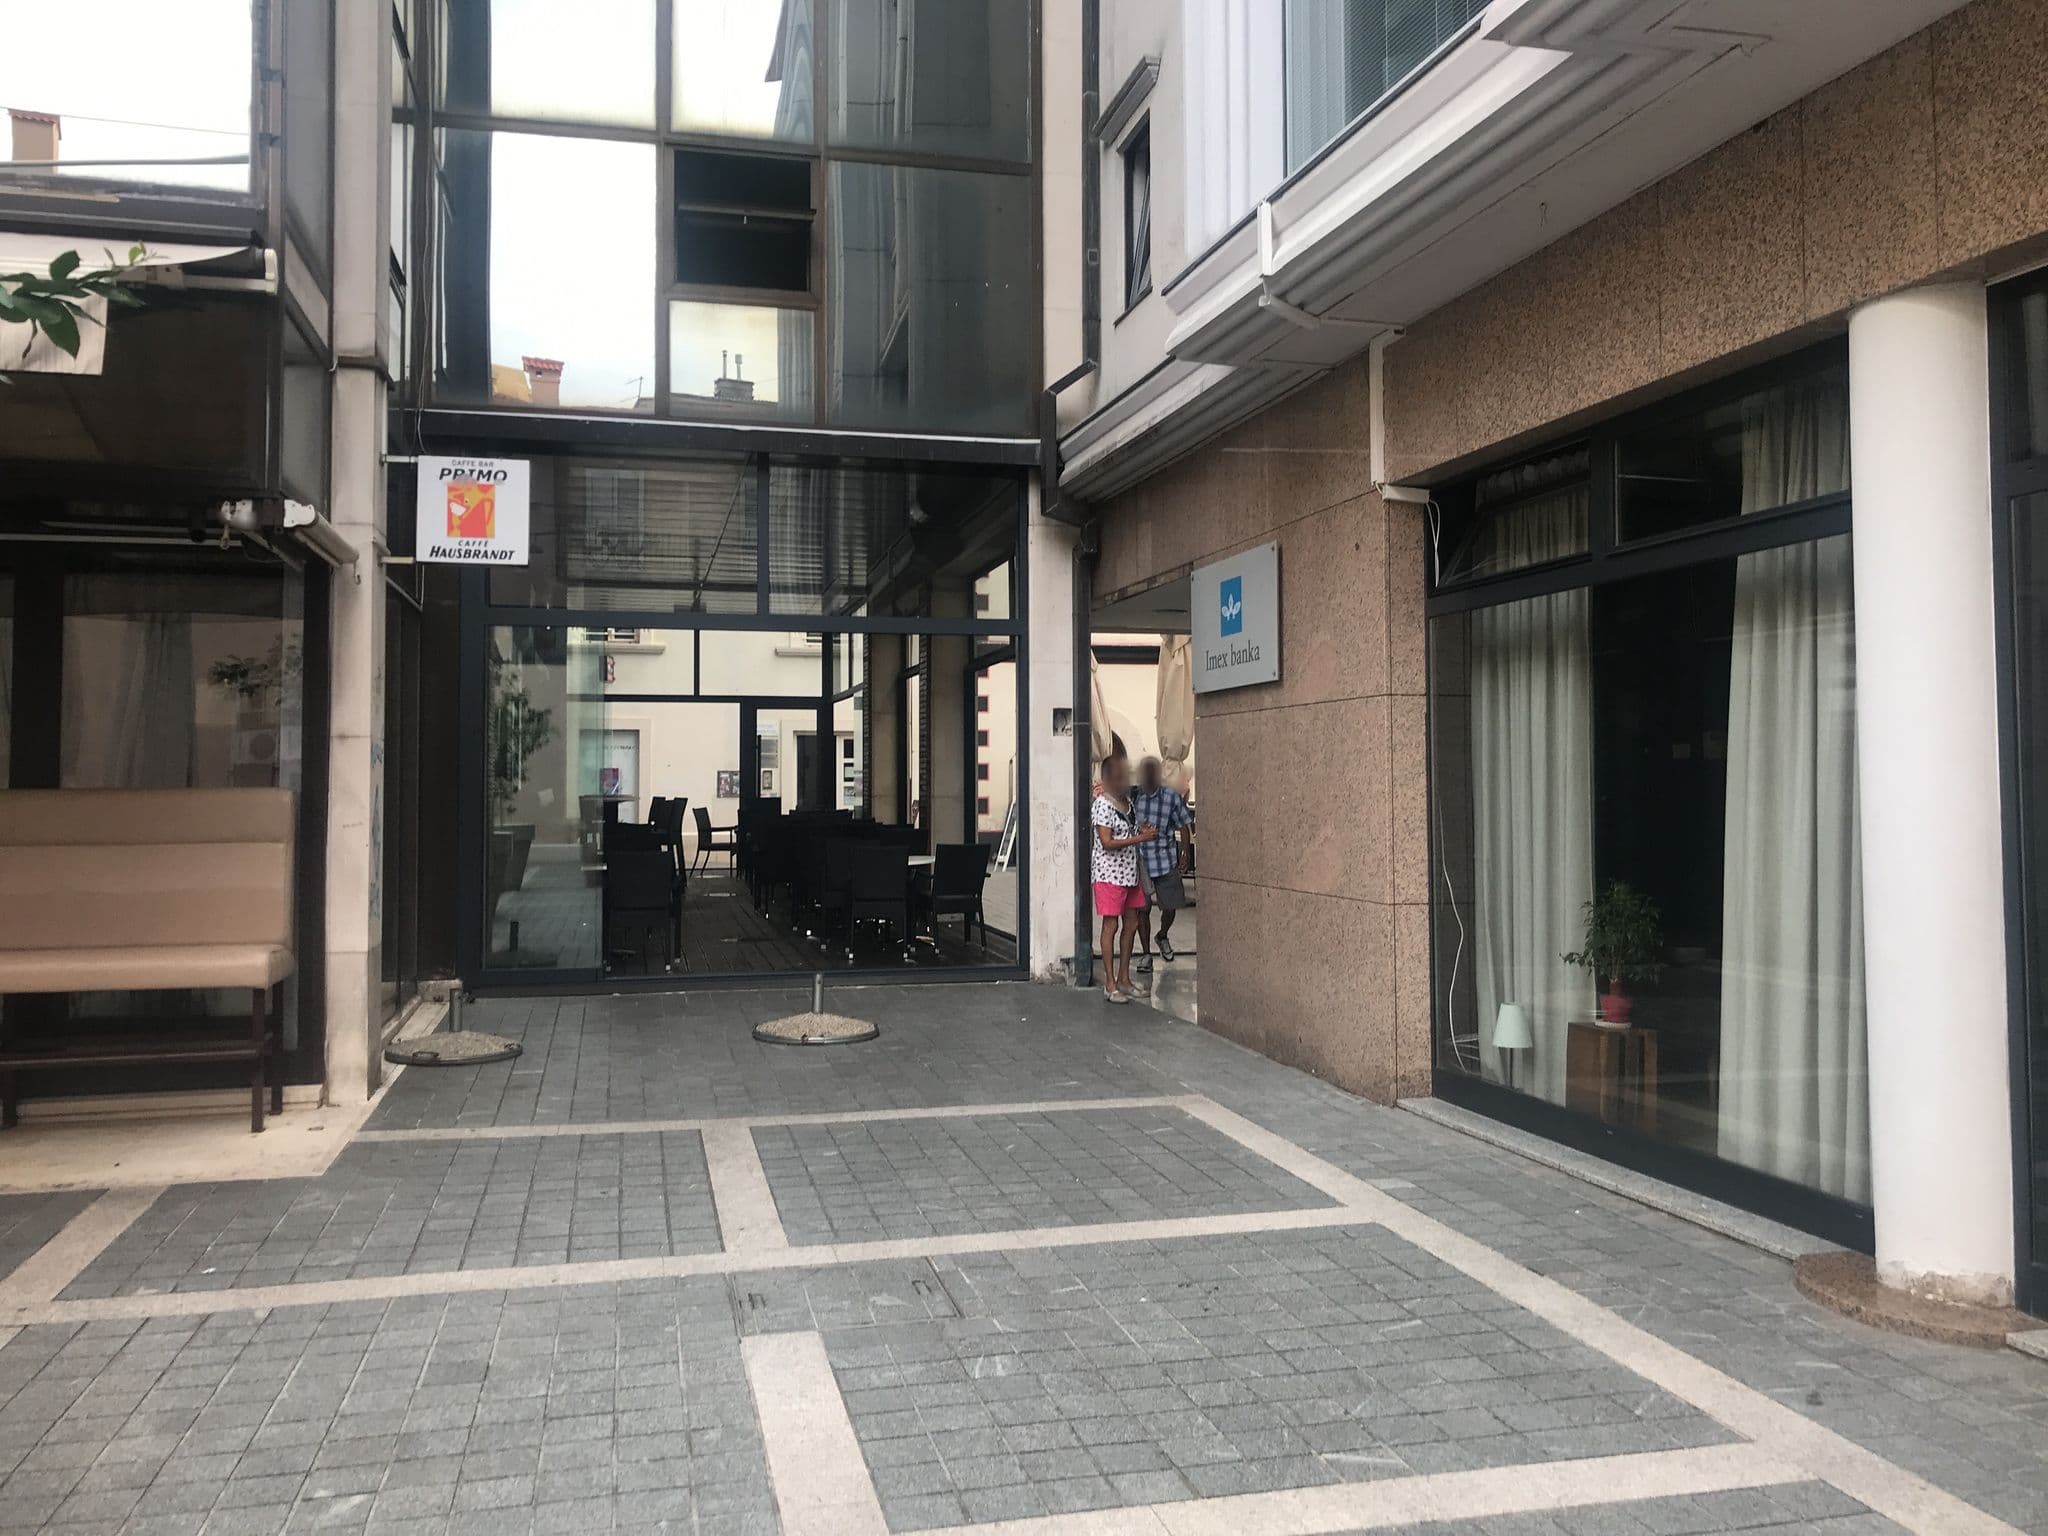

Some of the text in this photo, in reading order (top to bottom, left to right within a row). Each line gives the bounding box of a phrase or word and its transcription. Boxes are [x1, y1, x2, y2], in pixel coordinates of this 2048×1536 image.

[429, 545, 515, 560] HAUSBRANDT
[1205, 640, 1260, 671] Imex banka
